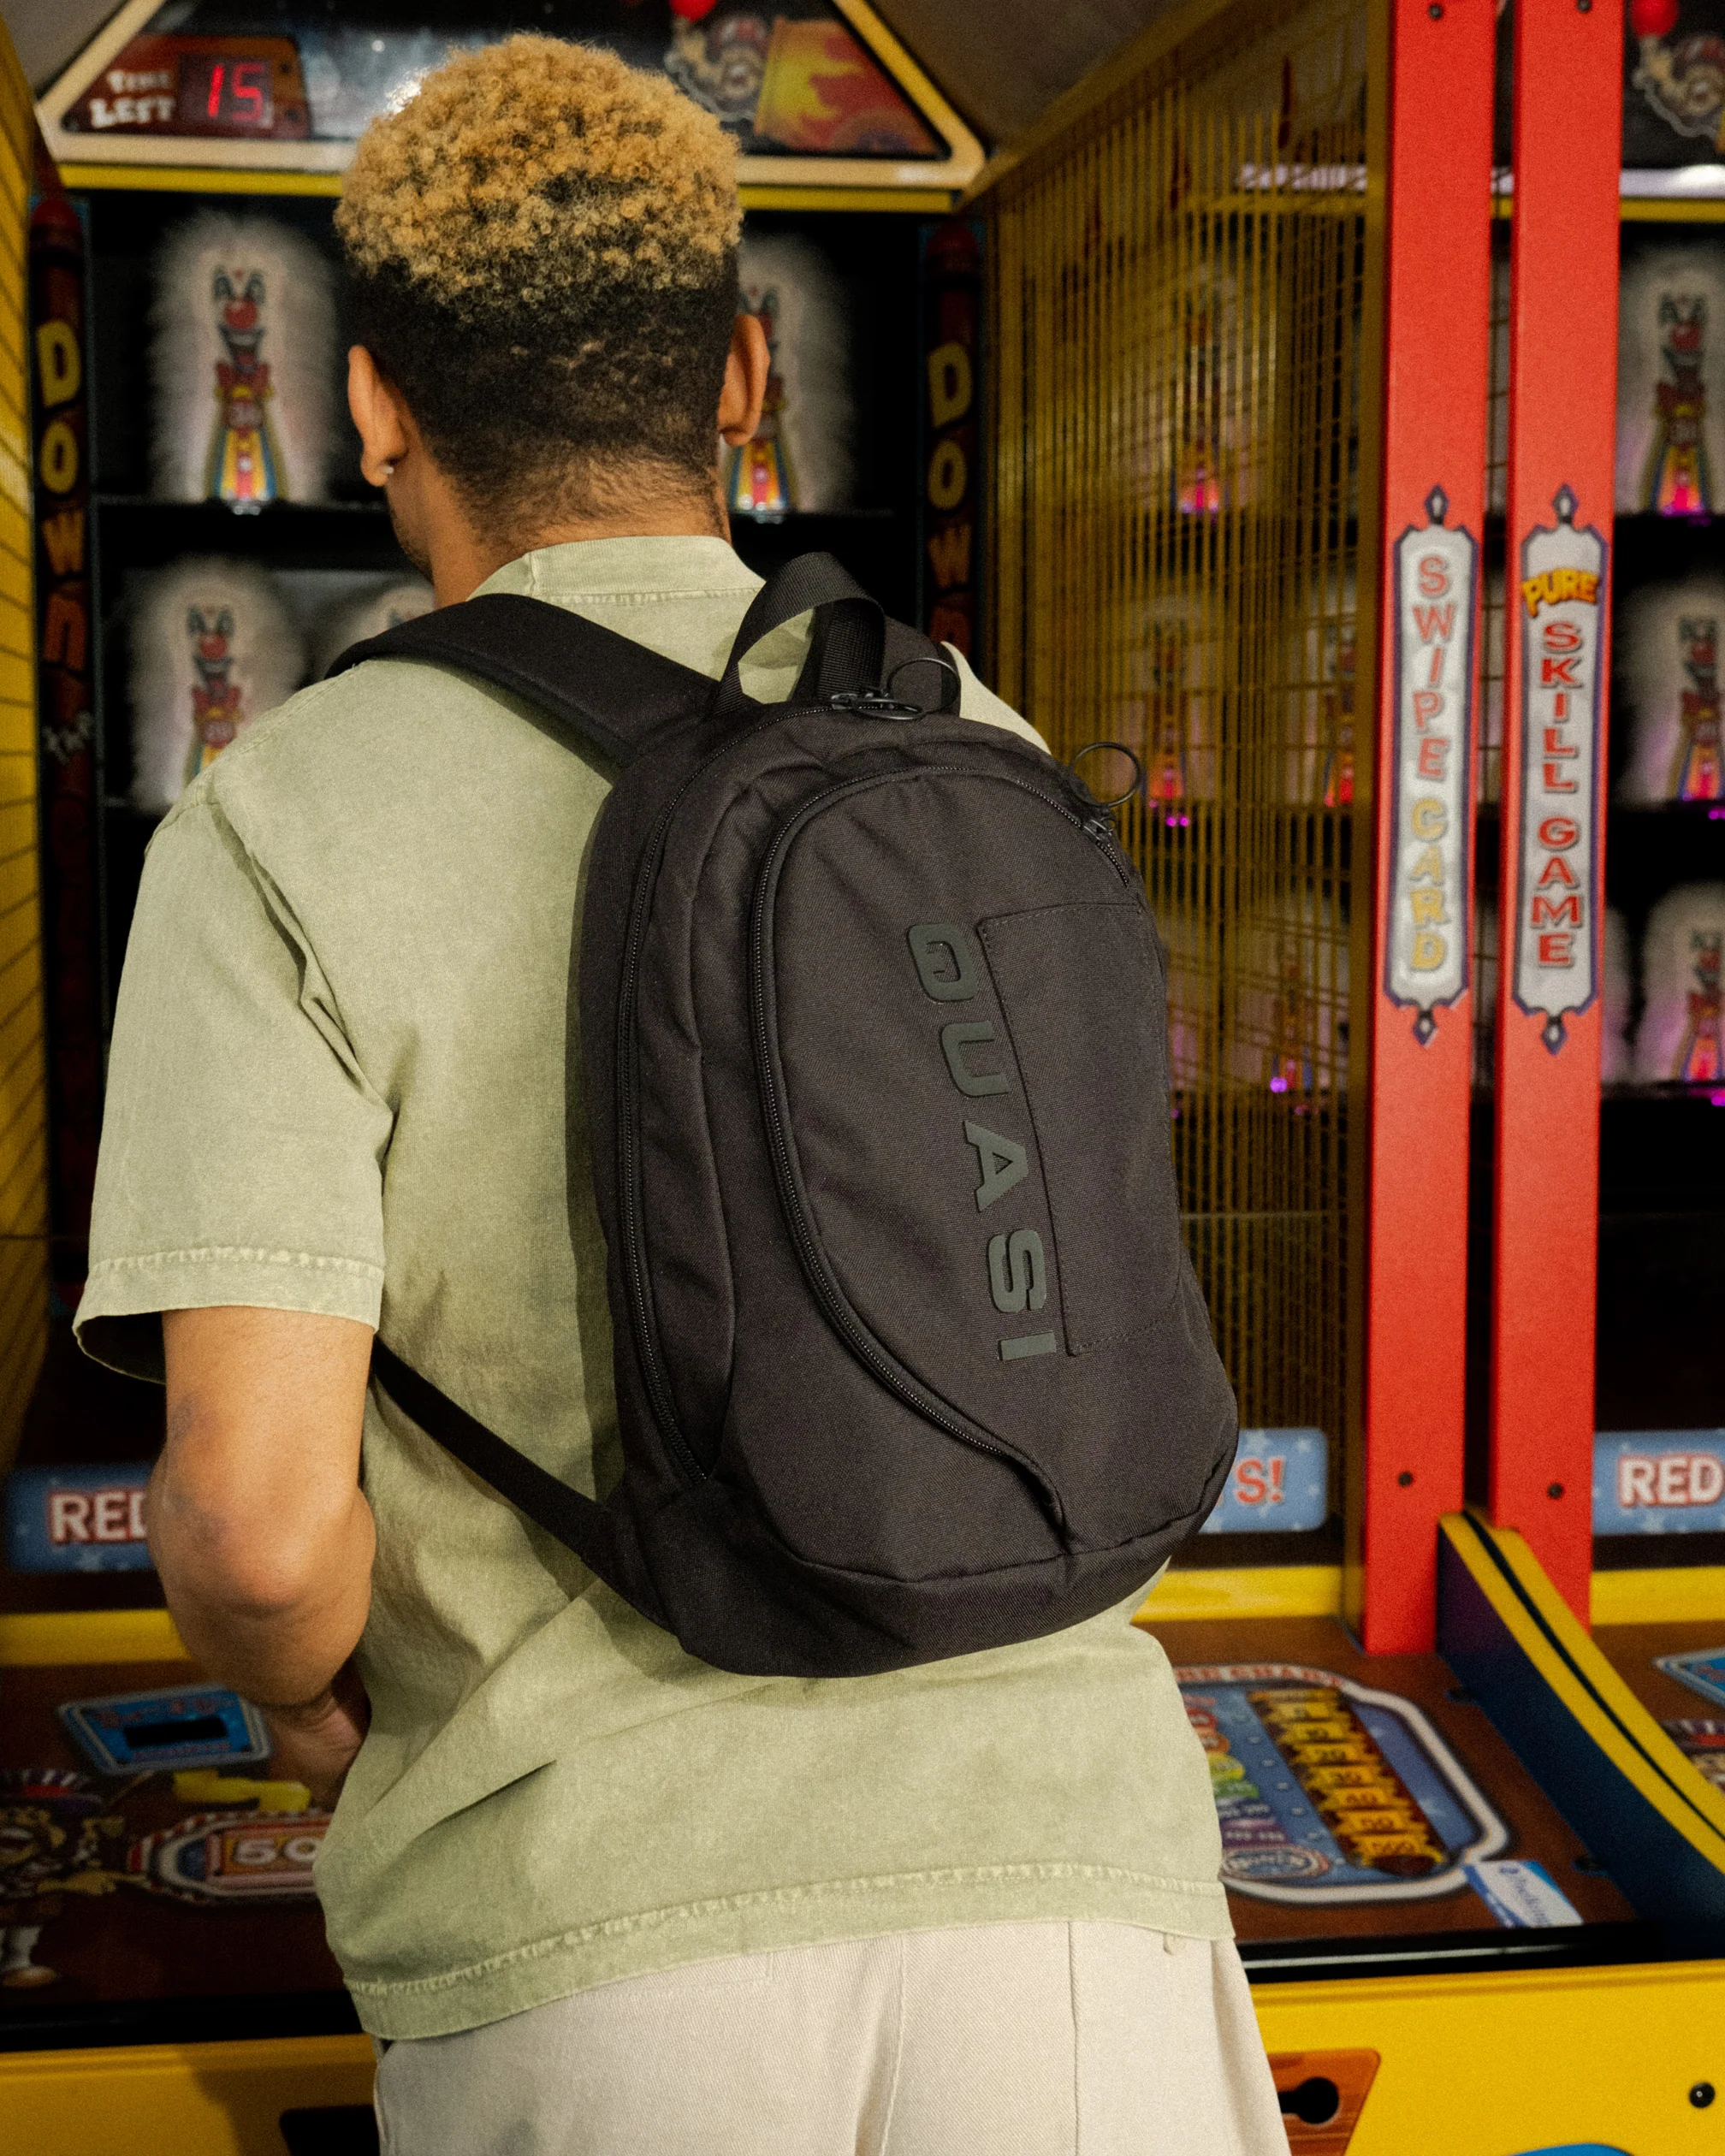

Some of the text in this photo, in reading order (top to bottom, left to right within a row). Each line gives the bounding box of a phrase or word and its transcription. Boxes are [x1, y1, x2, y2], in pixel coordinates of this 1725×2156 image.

[89, 96, 177, 128] LEFT
[207, 62, 265, 122] 15
[1521, 566, 1600, 619] PURE
[1408, 554, 1455, 973] SWIPE CARD
[1529, 620, 1584, 968] SKILL GAME
[905, 921, 1058, 1362] QUASI
[1216, 1456, 1285, 1507] S!
[1617, 1453, 1725, 1508] RED
